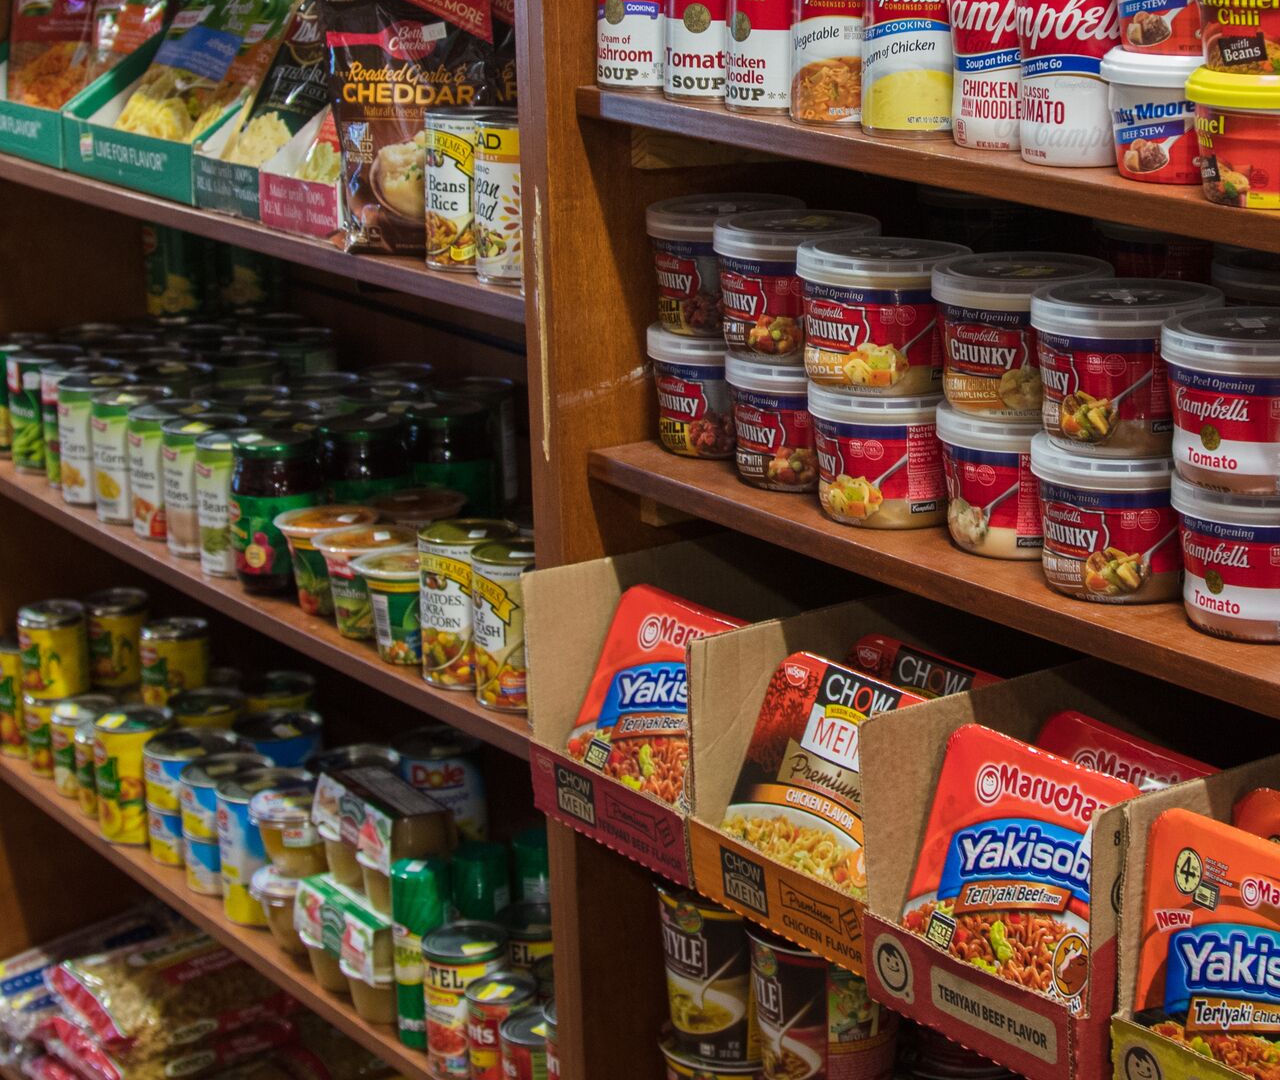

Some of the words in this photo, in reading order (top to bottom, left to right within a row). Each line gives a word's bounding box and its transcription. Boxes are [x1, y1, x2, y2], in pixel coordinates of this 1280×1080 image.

[445, 0, 485, 26] MORE
[625, 2, 656, 15] COOKING
[885, 2, 922, 10] CONDENSED
[923, 3, 942, 11] SOUP
[1218, 8, 1261, 27] Chili
[793, 26, 841, 50] Vegetable
[1230, 38, 1250, 51] with
[348, 61, 409, 83] Roasted
[406, 63, 451, 86] Garlic
[454, 64, 468, 84] &
[342, 83, 475, 106] CHEDDAR
[725, 87, 766, 102] SOUP
[962, 78, 1019, 98] CHICKEN
[974, 99, 1021, 121] NOODLE
[1136, 99, 1195, 120] Moore
[434, 132, 468, 158] HOLMES
[1121, 127, 1141, 141] BEEF
[1141, 124, 1166, 138] STEW
[95, 140, 113, 160] LIVE
[112, 145, 129, 162] FOR
[128, 148, 163, 171] FLAVOR
[429, 173, 466, 194] Beans
[431, 193, 459, 212] Rice
[950, 338, 1018, 370] CHUNKY
[1175, 385, 1251, 422] Campbell's
[1187, 446, 1238, 471] Tomato
[1180, 530, 1251, 569] Campbell's
[1194, 590, 1241, 615] Tomato
[430, 616, 461, 629] CORN
[857, 647, 882, 661] NISSIN
[410, 764, 465, 789] Dole
[557, 768, 592, 796] CHOW
[789, 753, 862, 803] Premium
[559, 794, 595, 821] MEIN
[724, 853, 762, 882] CHOW
[1179, 857, 1195, 882] 4
[725, 875, 766, 908] MEIN
[1156, 910, 1193, 930] New
[937, 983, 981, 1018] TERIYAKI
[981, 1005, 1006, 1029] BEEF
[1007, 1016, 1048, 1050] FLAVOR
